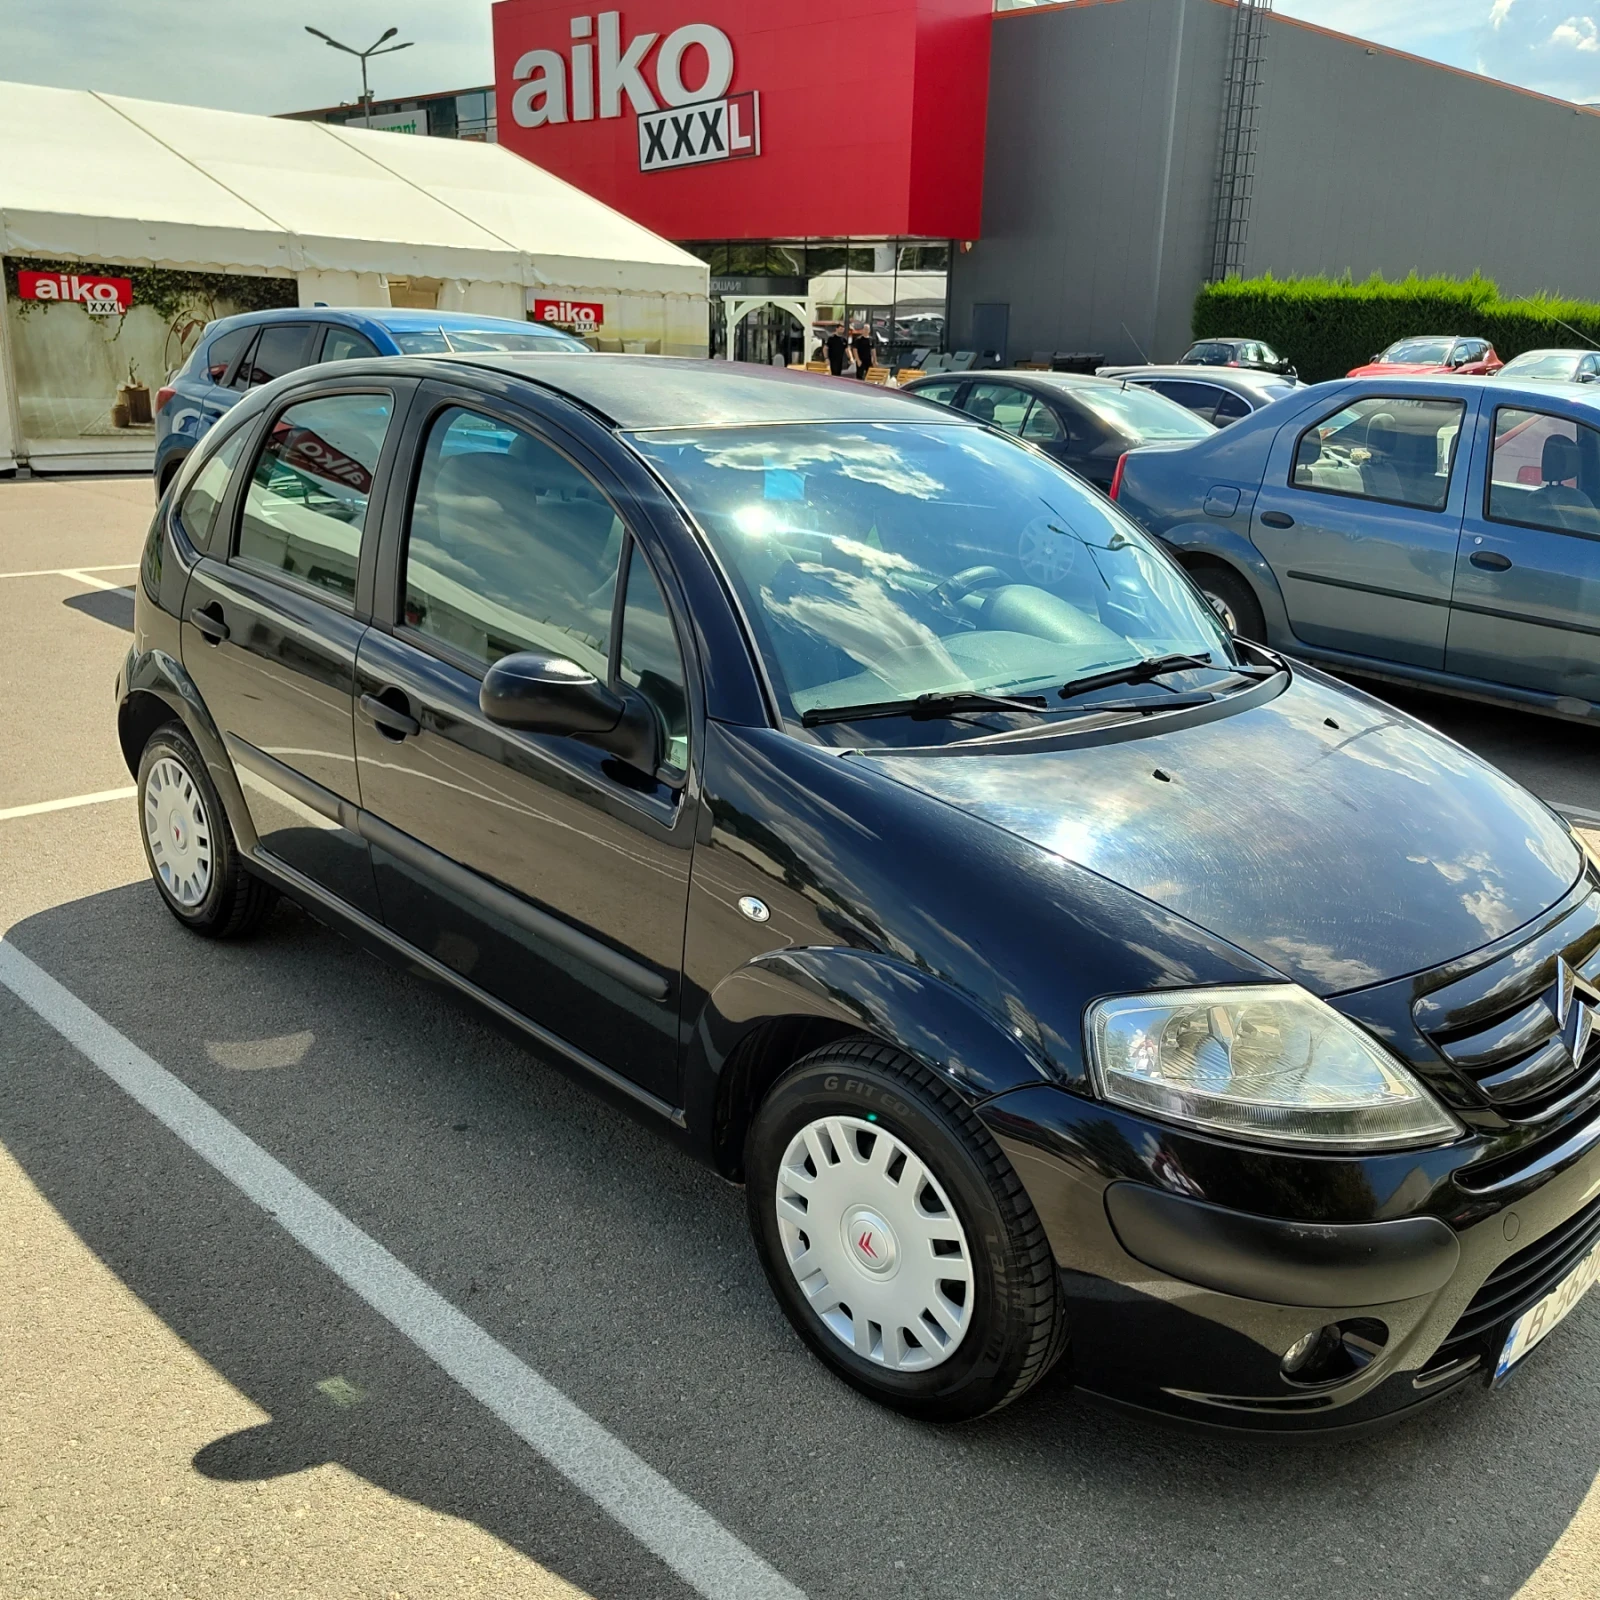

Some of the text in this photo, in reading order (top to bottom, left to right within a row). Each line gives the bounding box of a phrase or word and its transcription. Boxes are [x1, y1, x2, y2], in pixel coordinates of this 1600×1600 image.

[512, 11, 734, 128] aiko
[644, 104, 751, 164] XXXL
[35, 275, 119, 301] aiko
[90, 302, 126, 313] XXXL
[544, 302, 596, 321] aiko
[824, 1076, 839, 1091] G
[845, 1080, 878, 1098] FIT
[1525, 1300, 1549, 1347] B
